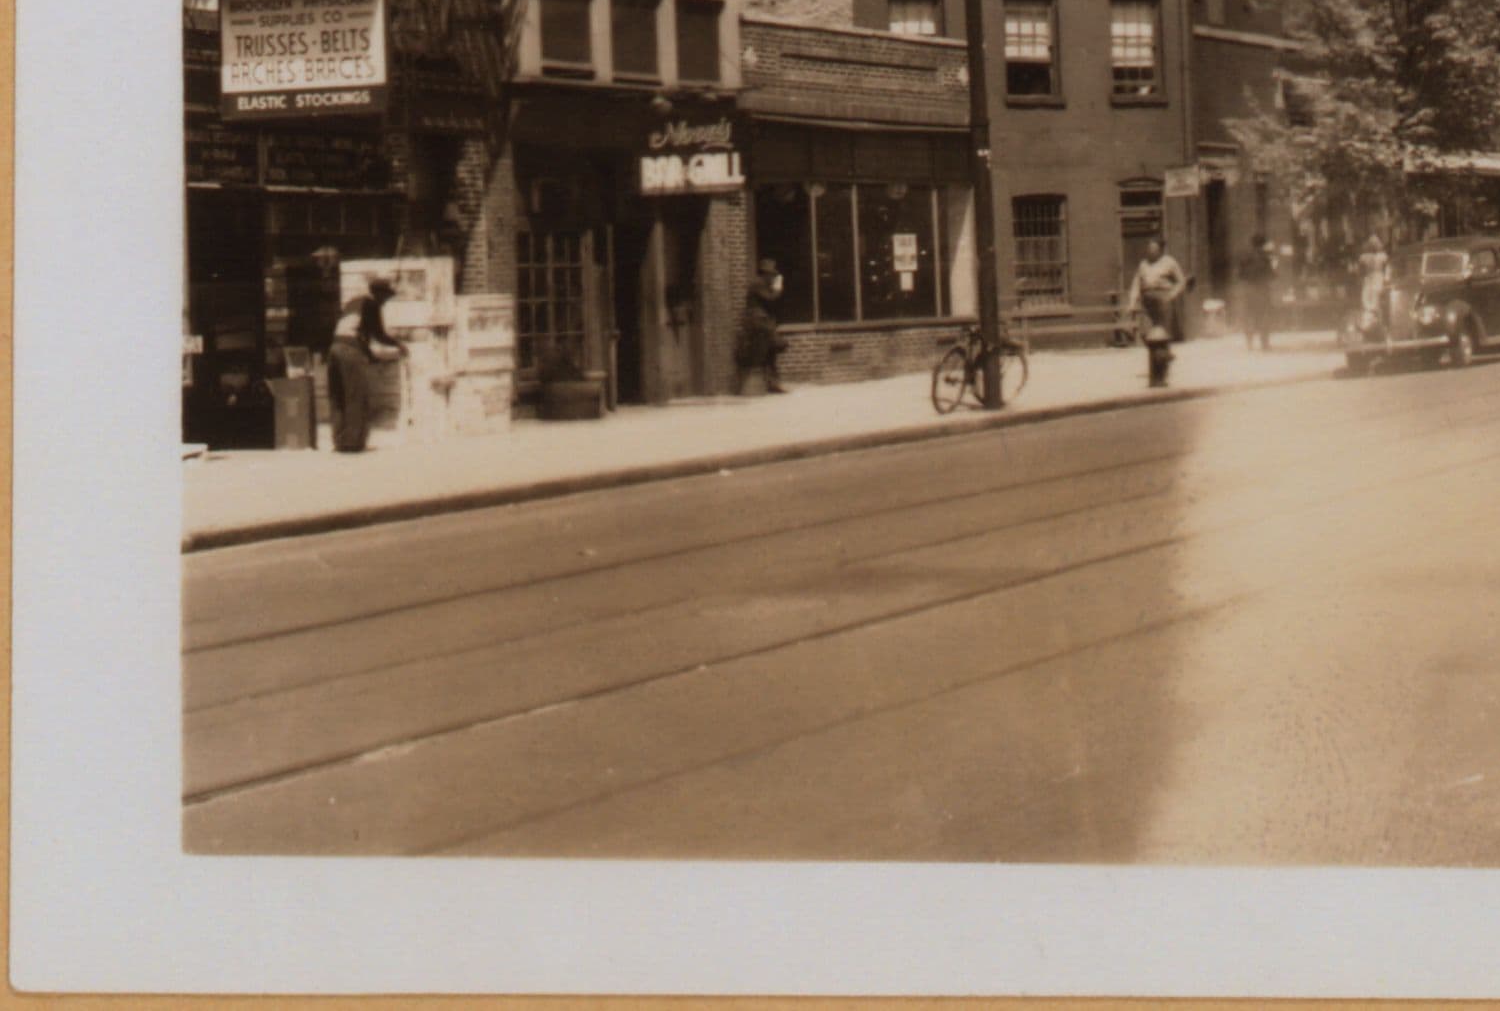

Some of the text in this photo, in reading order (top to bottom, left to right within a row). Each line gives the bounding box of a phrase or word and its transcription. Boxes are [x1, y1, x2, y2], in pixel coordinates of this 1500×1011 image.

[259, 13, 315, 27] SUPPLIES
[237, 91, 371, 111] ELASTIC STOCKINGS
